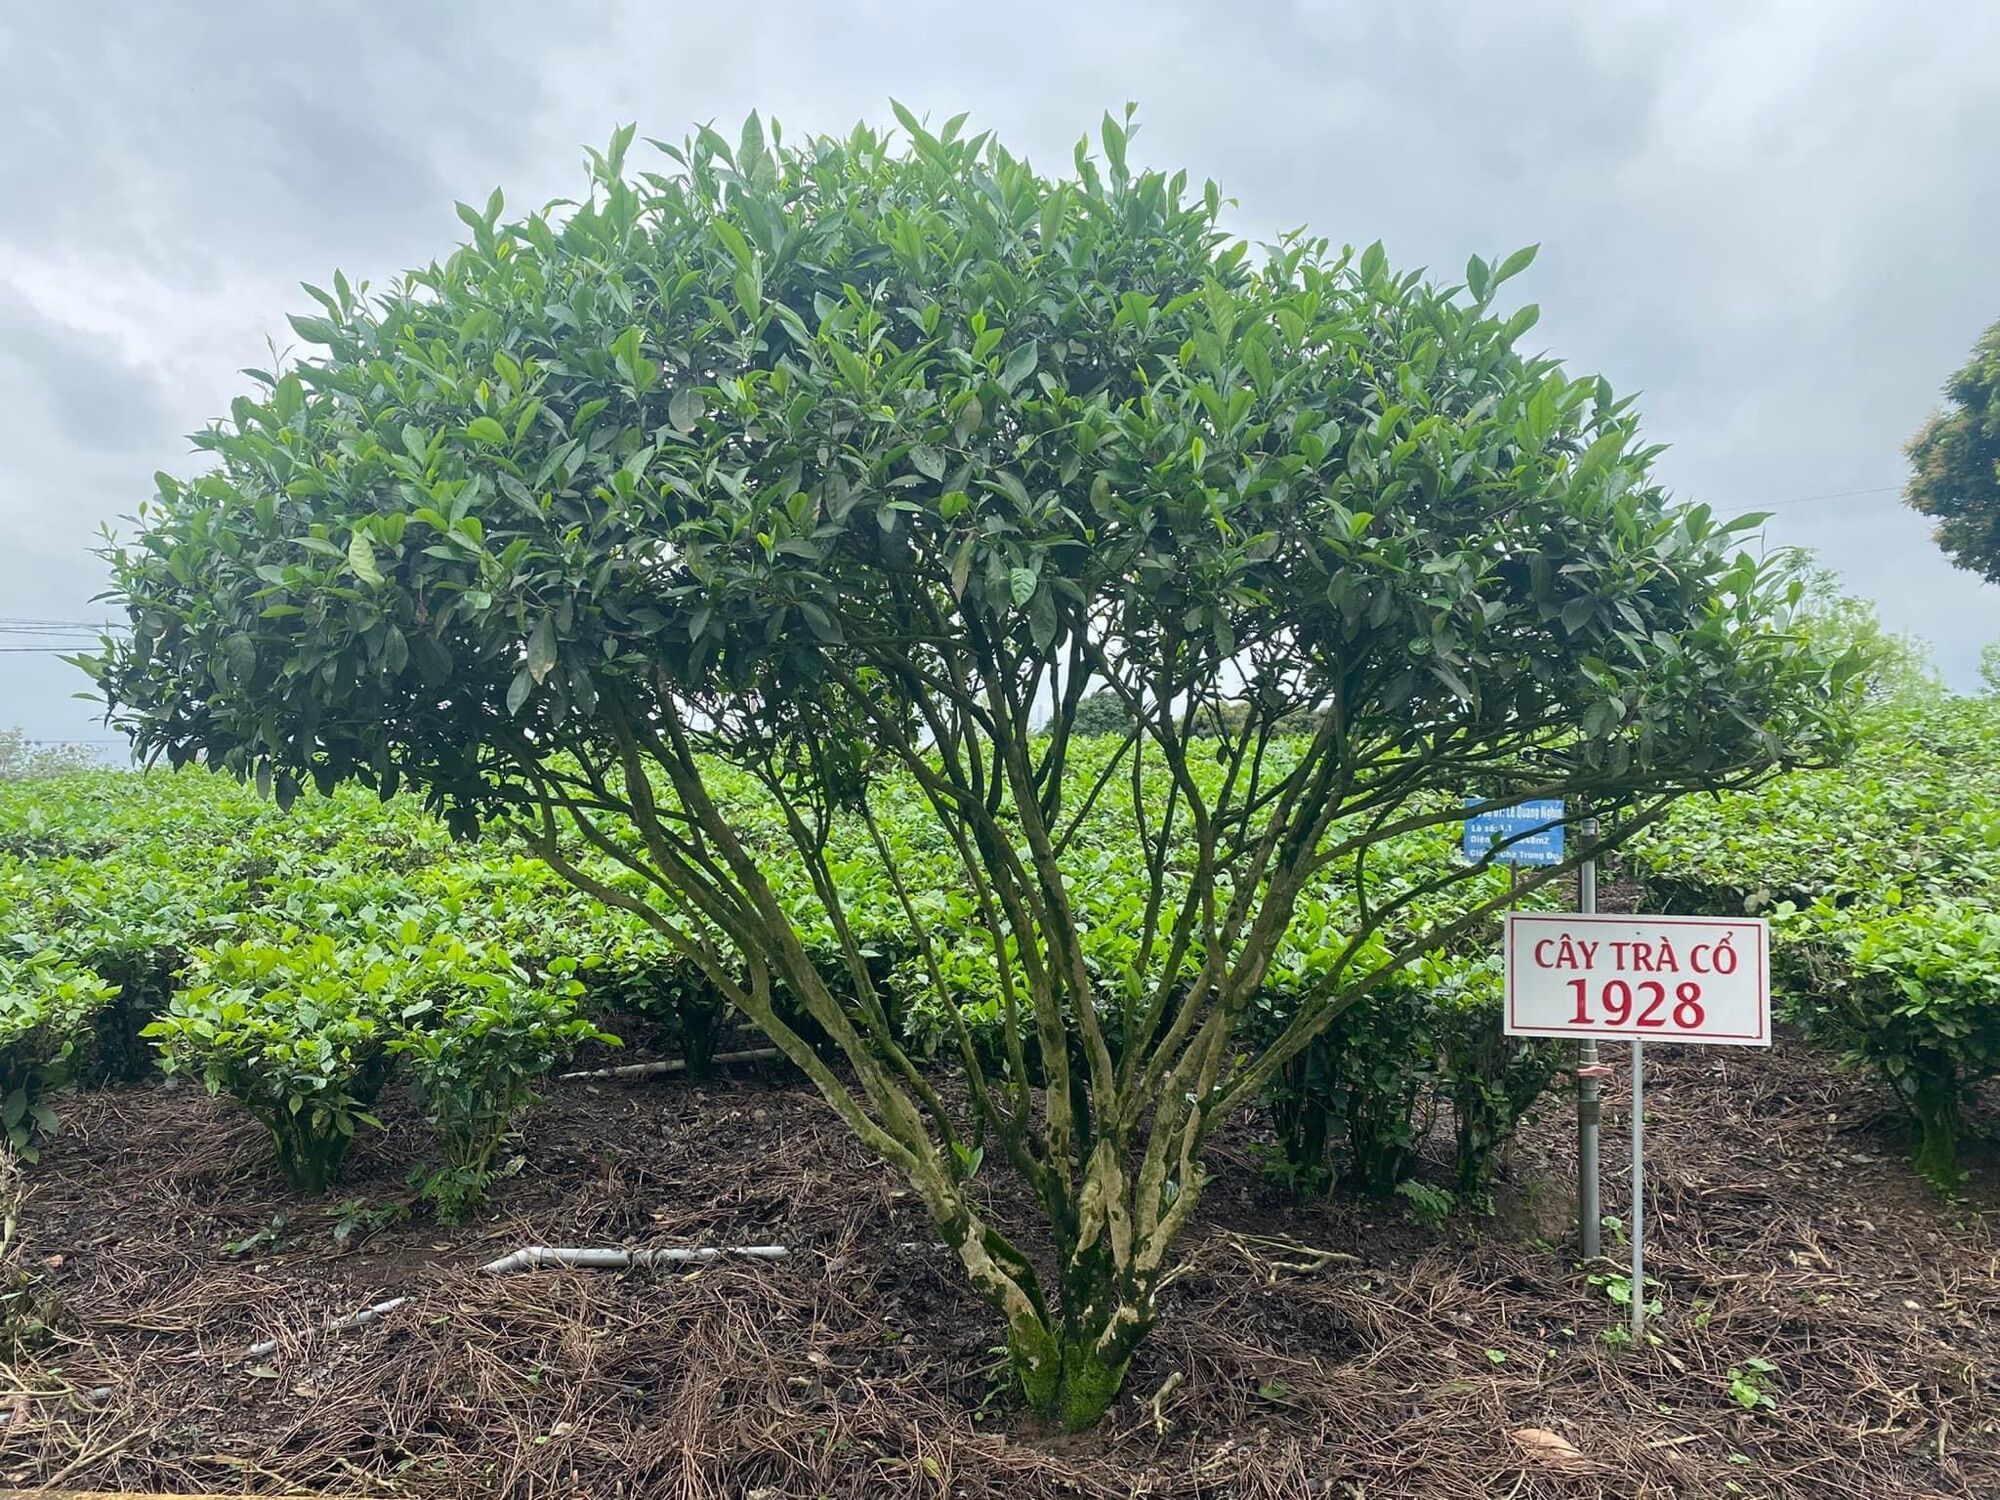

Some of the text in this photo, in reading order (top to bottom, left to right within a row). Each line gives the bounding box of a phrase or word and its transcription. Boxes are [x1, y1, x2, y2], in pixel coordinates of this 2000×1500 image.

[1534, 931, 1737, 974] CÂY TRÀ CỔ
[1566, 978, 1705, 1029] 1928
